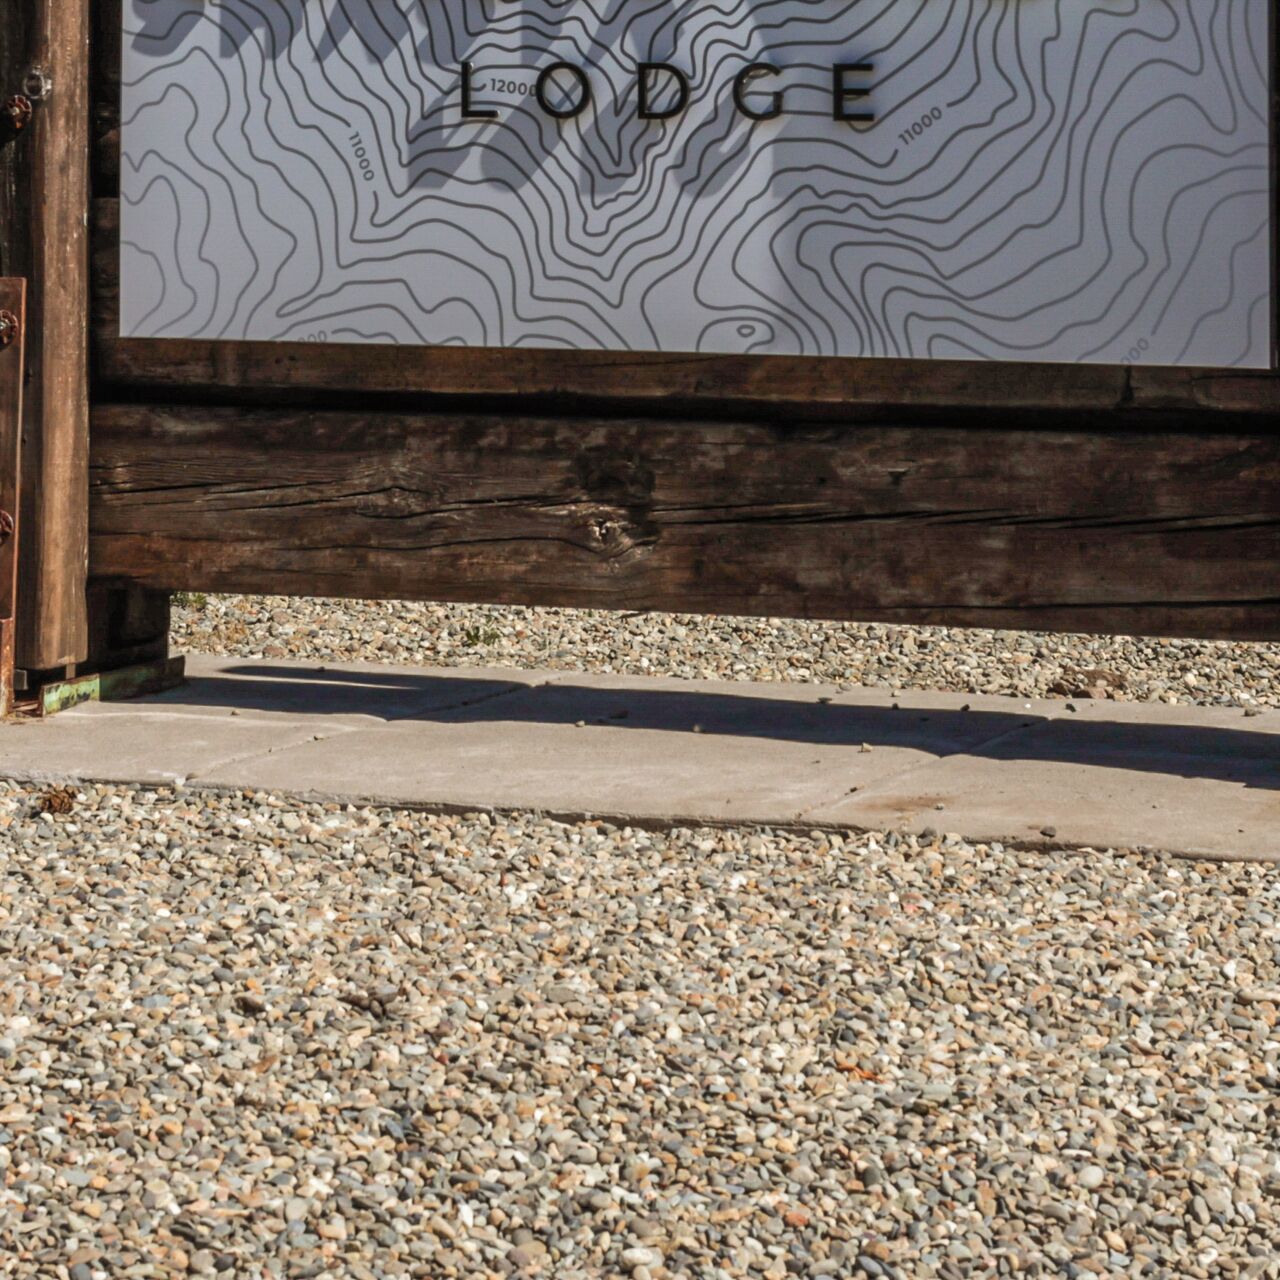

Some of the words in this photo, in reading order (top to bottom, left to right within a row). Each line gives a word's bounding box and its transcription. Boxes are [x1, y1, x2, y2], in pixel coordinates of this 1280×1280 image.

[459, 61, 876, 122] LODGE
[897, 105, 943, 147] 11000
[347, 130, 375, 183] 11000
